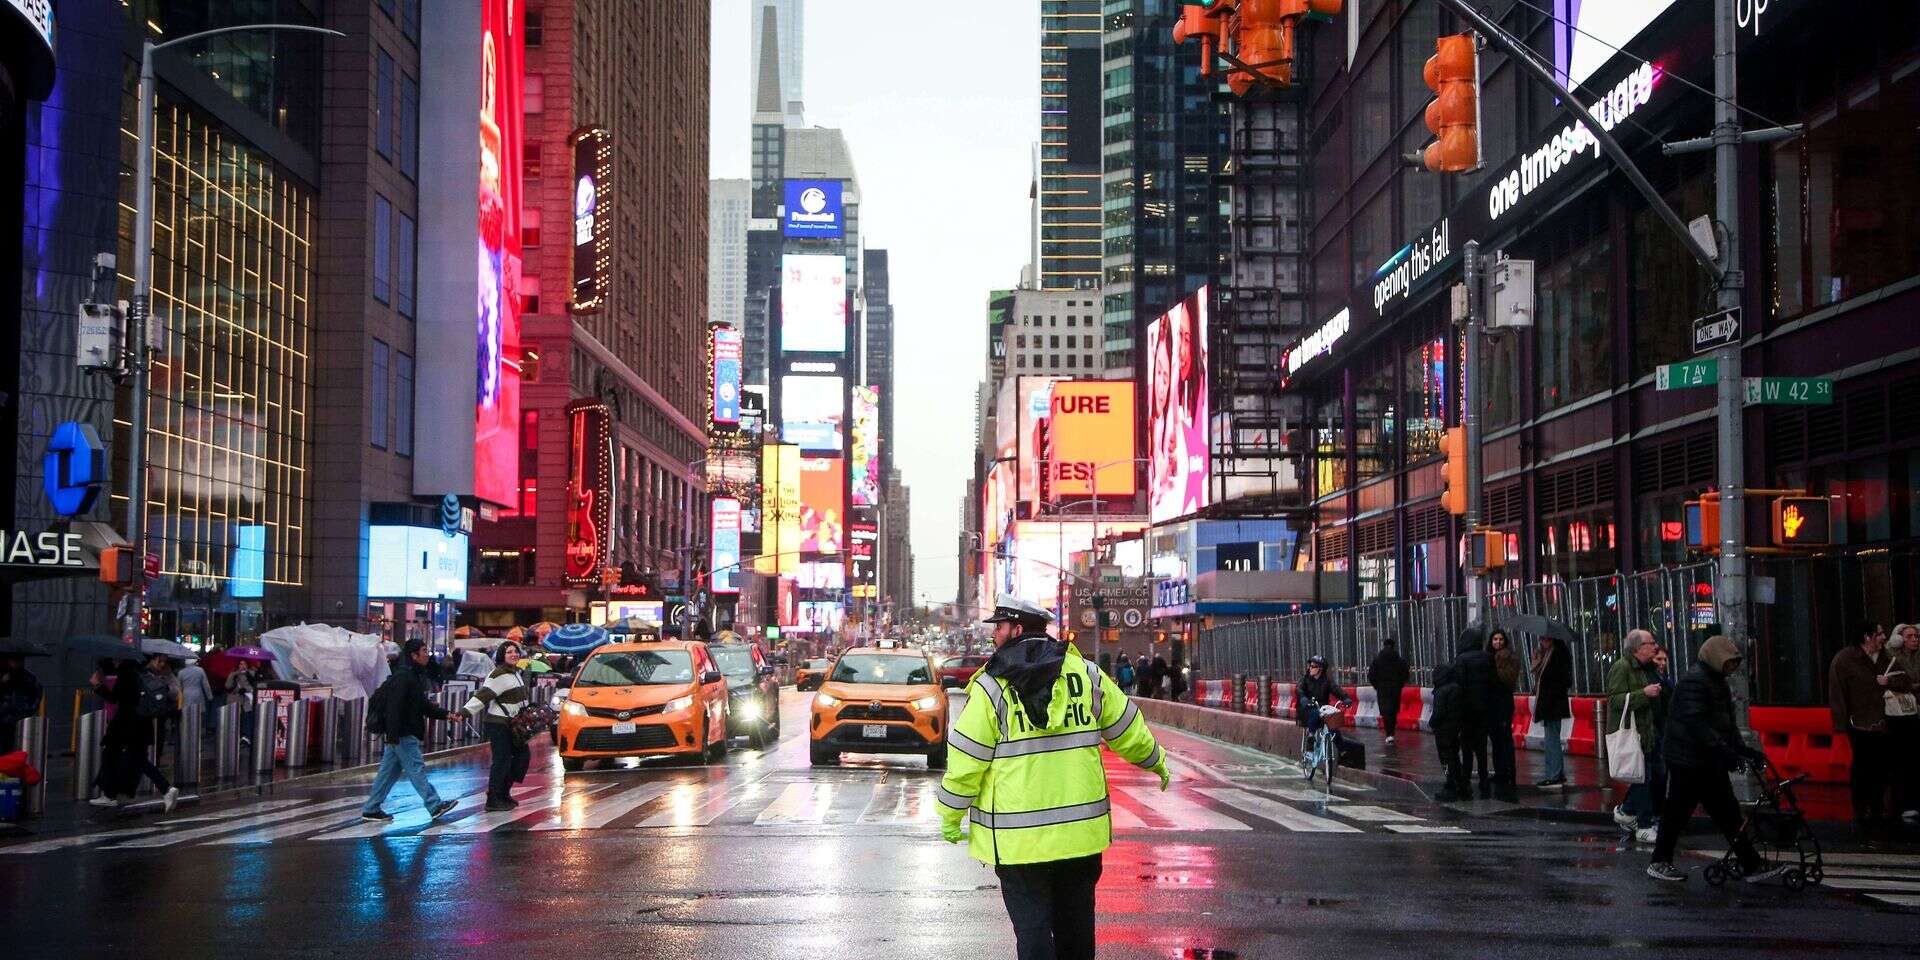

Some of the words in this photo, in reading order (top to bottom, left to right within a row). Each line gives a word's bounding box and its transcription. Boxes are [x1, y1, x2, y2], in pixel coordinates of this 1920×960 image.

[17, 0, 47, 31] ASE
[1489, 169, 1520, 220] one
[1520, 126, 1574, 196] times
[1374, 258, 1410, 316] opening
[1411, 237, 1430, 281] this
[1432, 217, 1450, 265] fall
[1700, 330, 1712, 341] ONE
[1718, 319, 1734, 336] WAY
[1682, 366, 1689, 384] 7
[1694, 364, 1707, 376] Av
[1765, 382, 1780, 399] W
[1789, 382, 1809, 400] 42
[1816, 383, 1829, 394] St
[0, 530, 84, 566] ASE
[1014, 703, 1091, 732] TFIC
